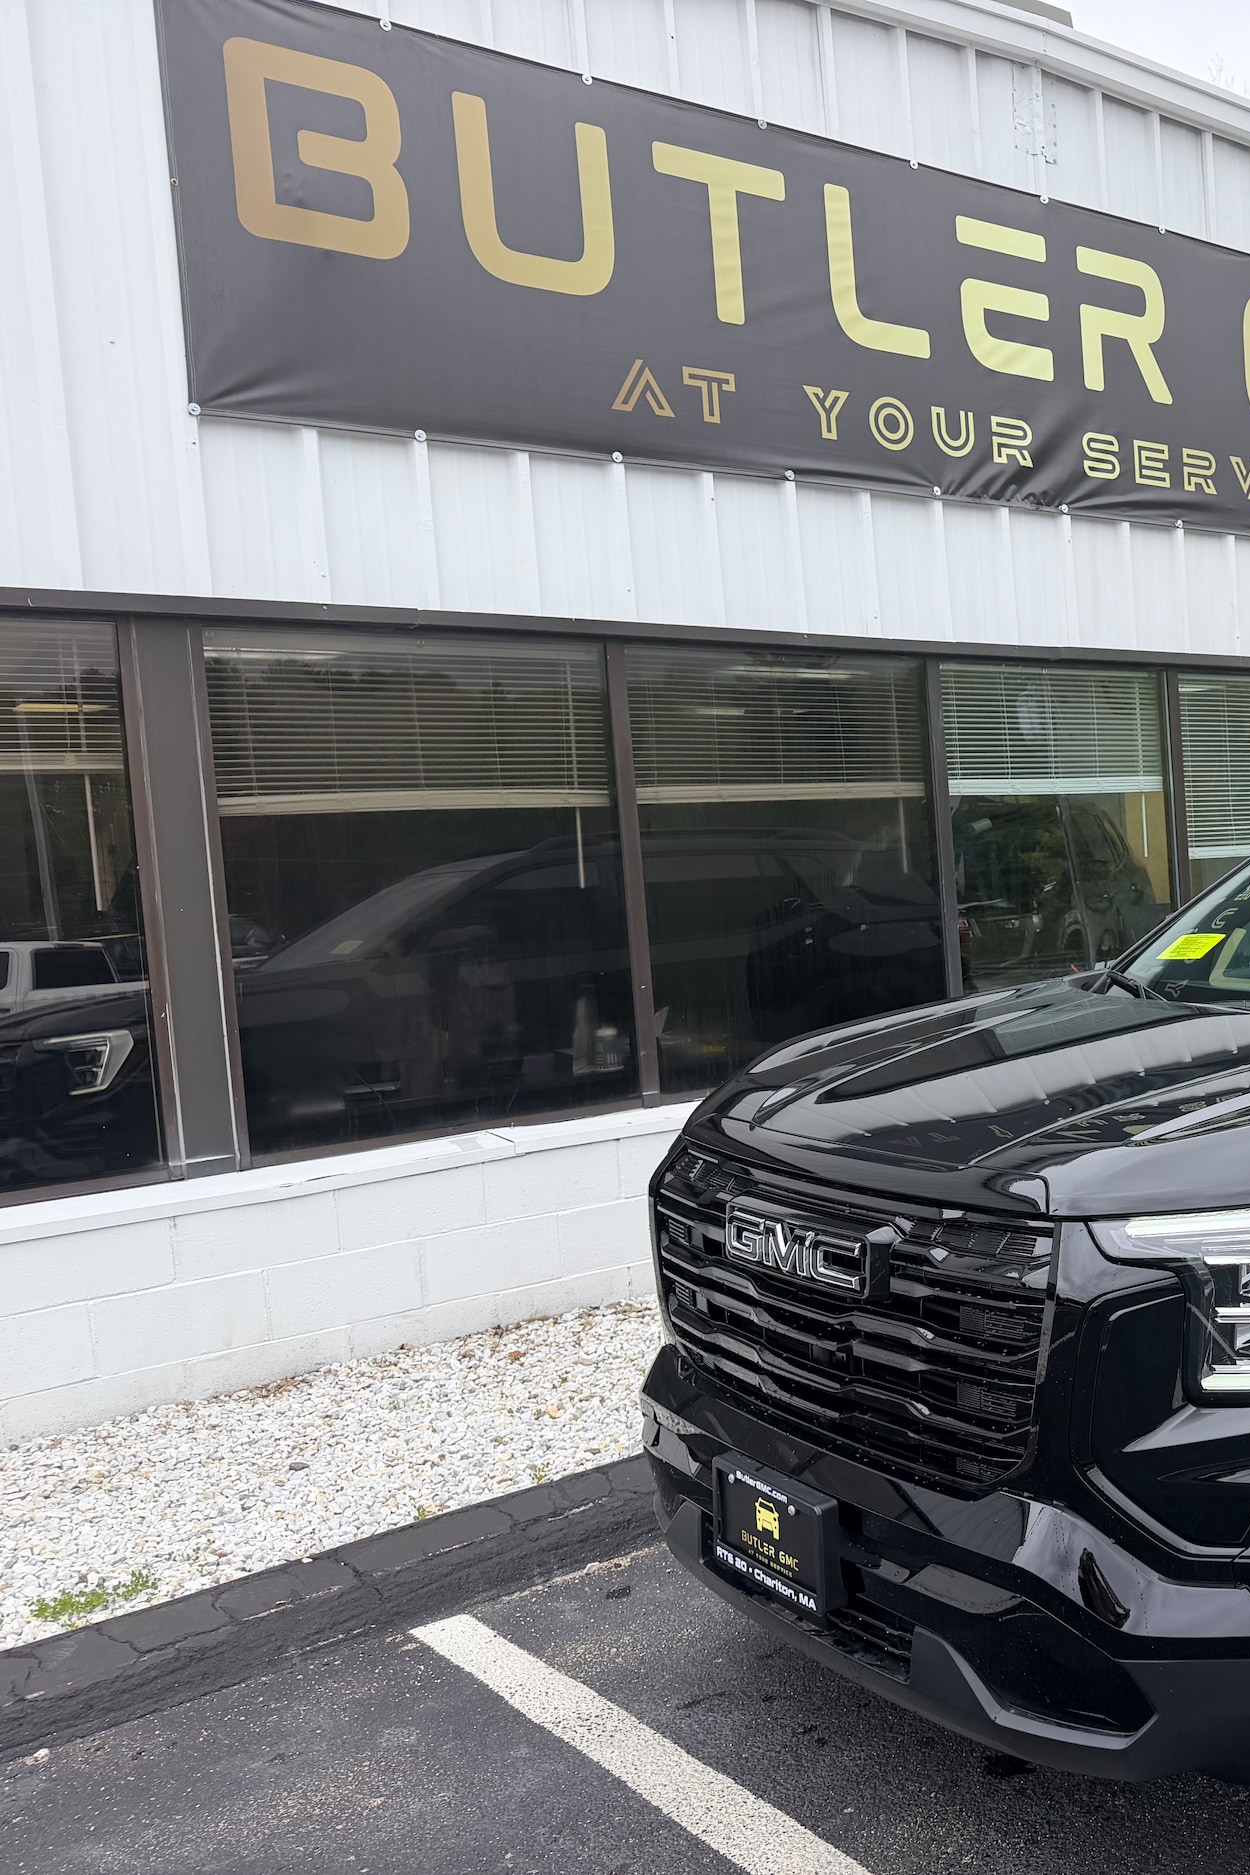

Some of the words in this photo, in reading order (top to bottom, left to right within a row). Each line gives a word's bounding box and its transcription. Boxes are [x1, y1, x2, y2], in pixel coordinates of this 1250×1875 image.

[222, 36, 1173, 405] BUTLER
[611, 358, 736, 424] AT
[802, 384, 1033, 468] YOUR
[726, 1210, 863, 1290] GMC
[736, 1470, 788, 1504] ButlerGMC.com
[735, 1556, 747, 1572] 20
[754, 1567, 798, 1603] Charlton,
[798, 1592, 817, 1611] MA
[741, 1529, 776, 1558] BUTLER
[778, 1551, 799, 1572] GMC
